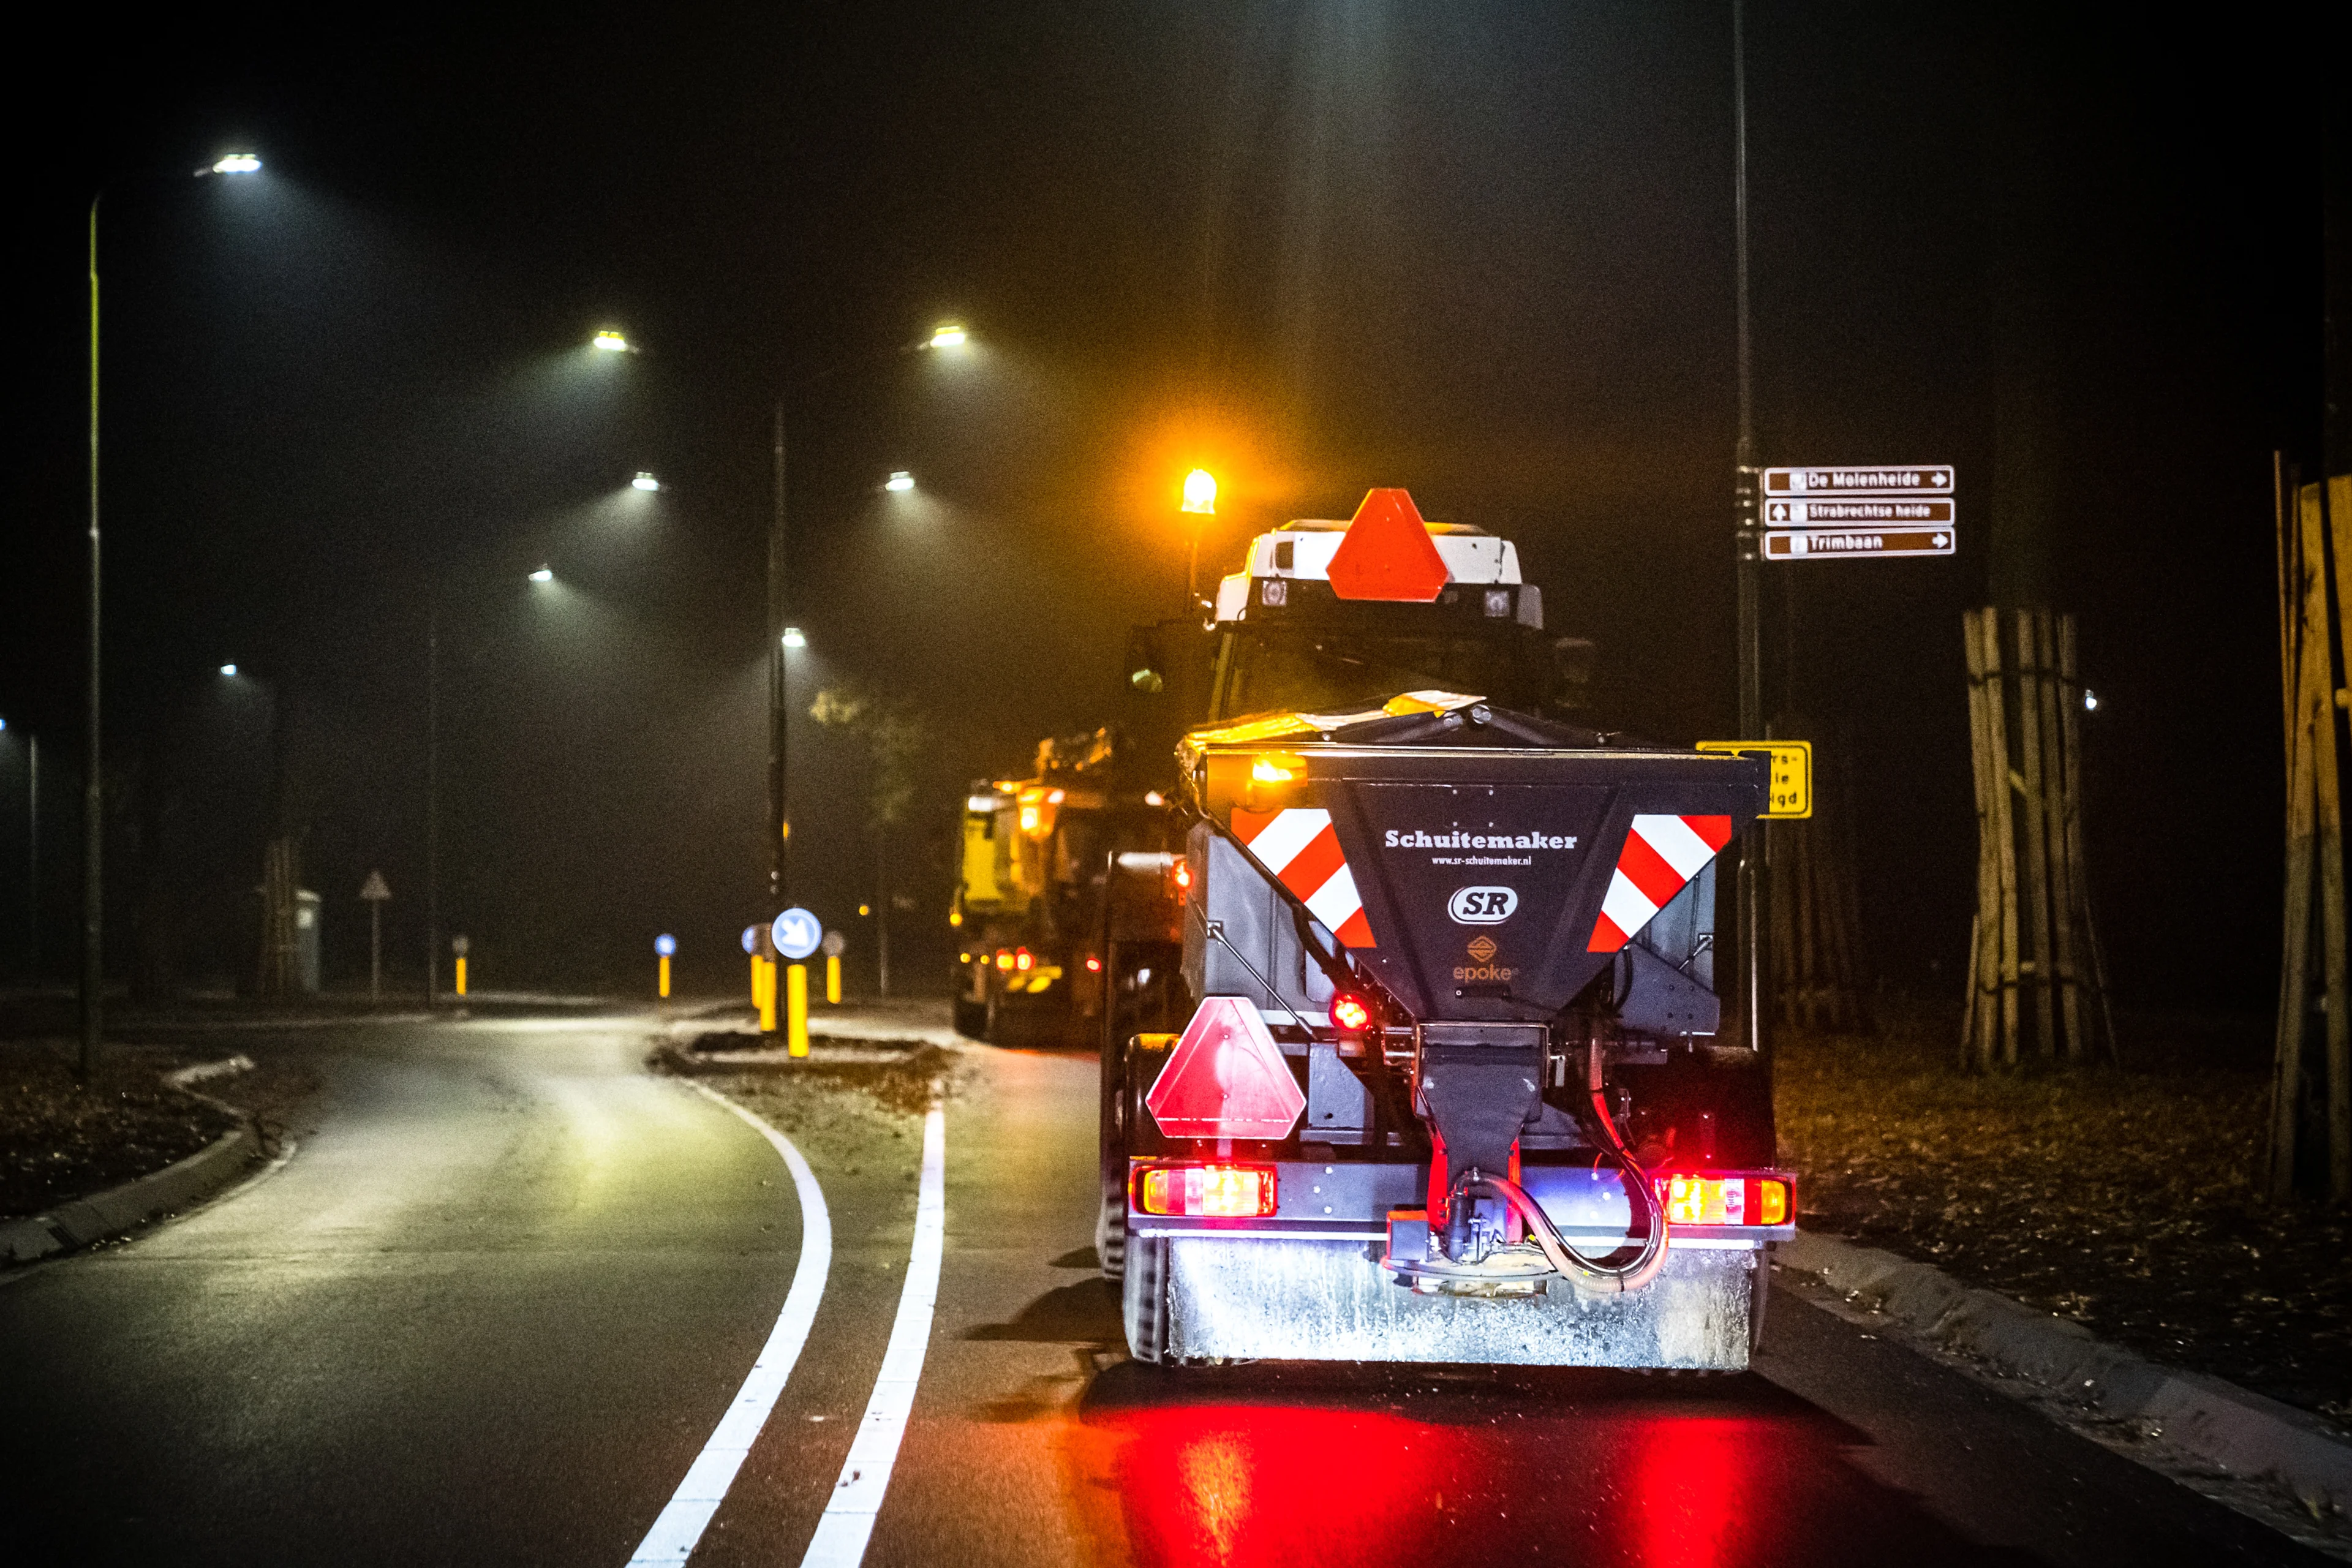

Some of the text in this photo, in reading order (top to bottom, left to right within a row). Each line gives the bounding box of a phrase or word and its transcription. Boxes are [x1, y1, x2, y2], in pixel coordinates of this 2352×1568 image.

[1808, 472, 1920, 488] De Molenheide
[1809, 503, 1931, 518] Strabrechtse heide
[1810, 535, 1883, 551] Trimbaan
[1771, 755, 1798, 765] rs-
[1770, 791, 1797, 808] igd
[1385, 829, 1578, 850] Schuitemaker
[1431, 855, 1532, 865] www.sr-schuitemaker.nl
[1462, 892, 1509, 916] SR
[1453, 963, 1512, 984] epoke
